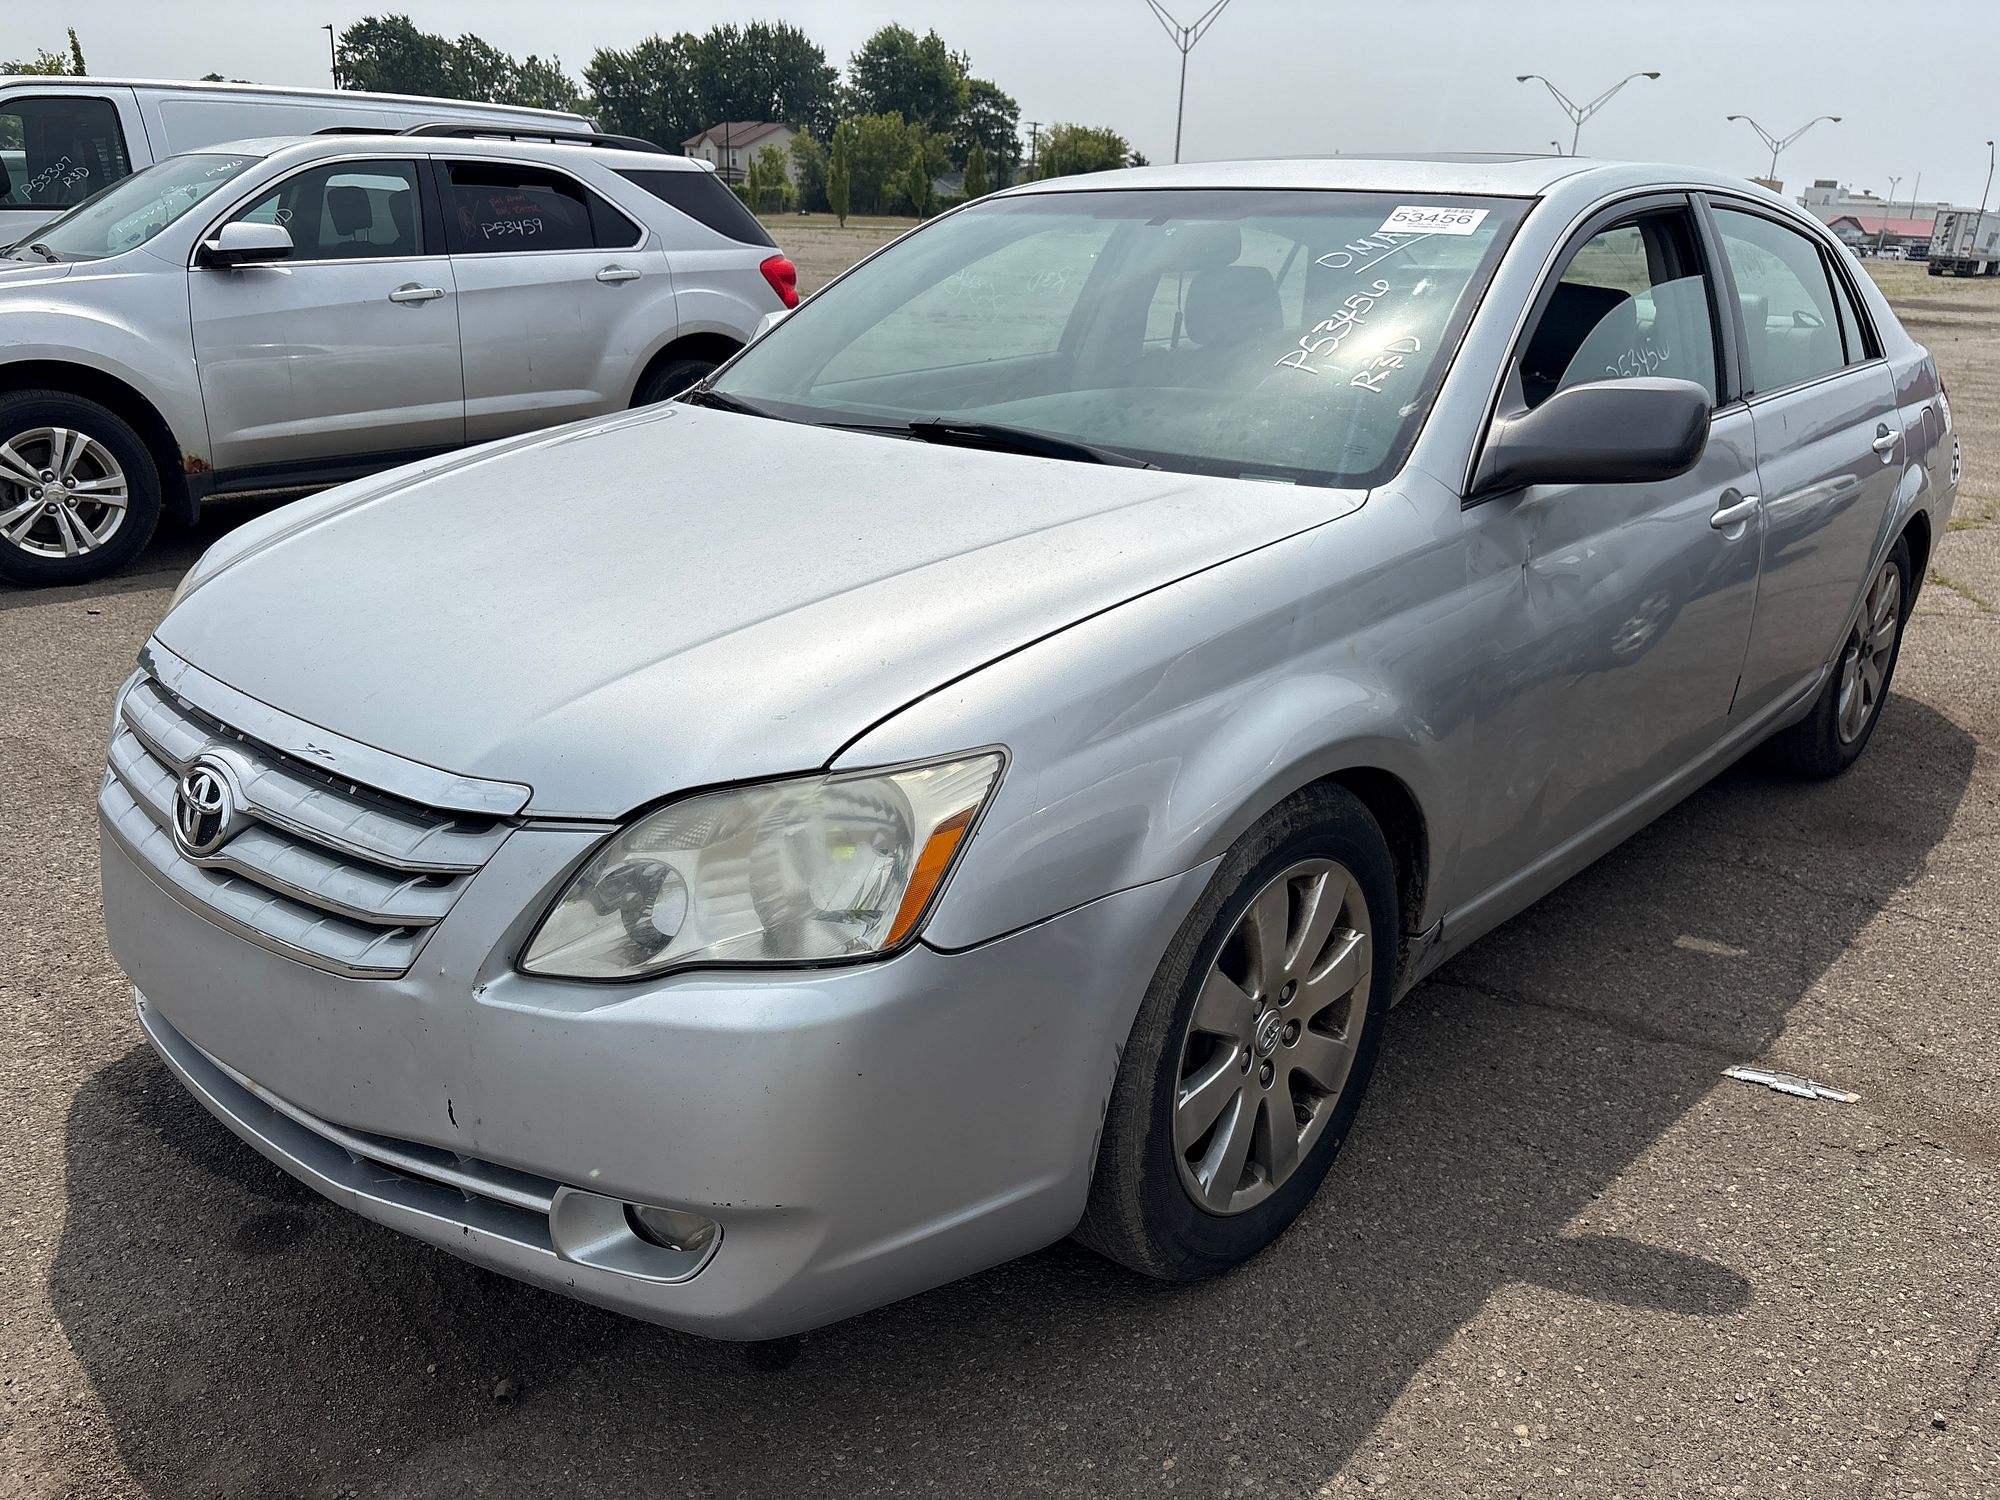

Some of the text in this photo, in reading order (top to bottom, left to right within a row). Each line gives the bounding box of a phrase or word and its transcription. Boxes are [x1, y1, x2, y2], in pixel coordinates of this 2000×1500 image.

[19, 155, 72, 201] P53307
[62, 167, 90, 189] R3D
[480, 217, 544, 240] P53459
[1392, 212, 1473, 225] 53456
[1274, 278, 1391, 375] P53456
[1350, 336, 1421, 393] R3D
